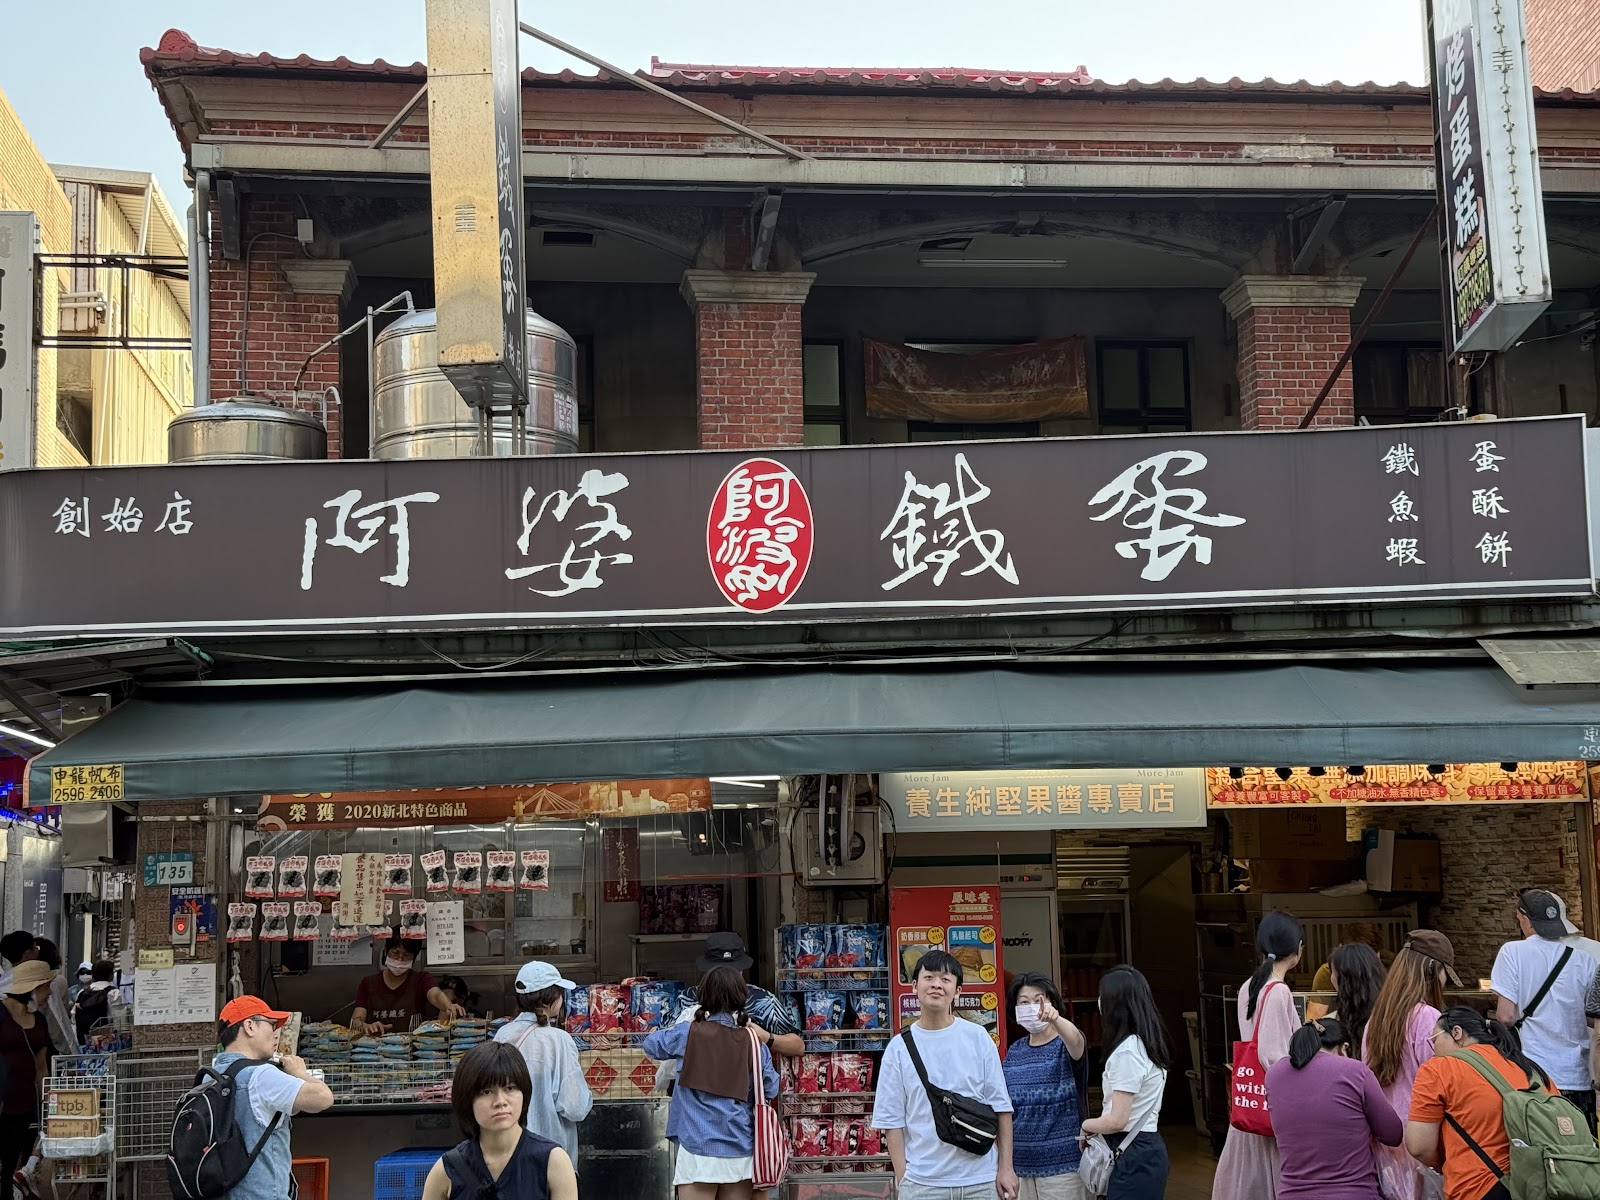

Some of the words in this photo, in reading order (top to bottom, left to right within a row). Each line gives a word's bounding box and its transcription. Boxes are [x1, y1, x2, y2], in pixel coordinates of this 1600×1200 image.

[53, 490, 193, 538] 創始店
[903, 773, 929, 783] More
[930, 773, 950, 783] Jam
[1136, 769, 1163, 778] More
[1166, 768, 1184, 777] Jam
[905, 782, 1175, 818] 養生純堅果醬專賣店
[289, 803, 335, 822] 榮獲
[344, 802, 468, 819] 2020新北特色商品
[160, 866, 187, 879] 135
[952, 891, 991, 903] 原味香
[1002, 937, 1033, 947] NOOPY
[1236, 1066, 1255, 1078] go
[1235, 1082, 1267, 1096] with
[1234, 1096, 1259, 1109] the
